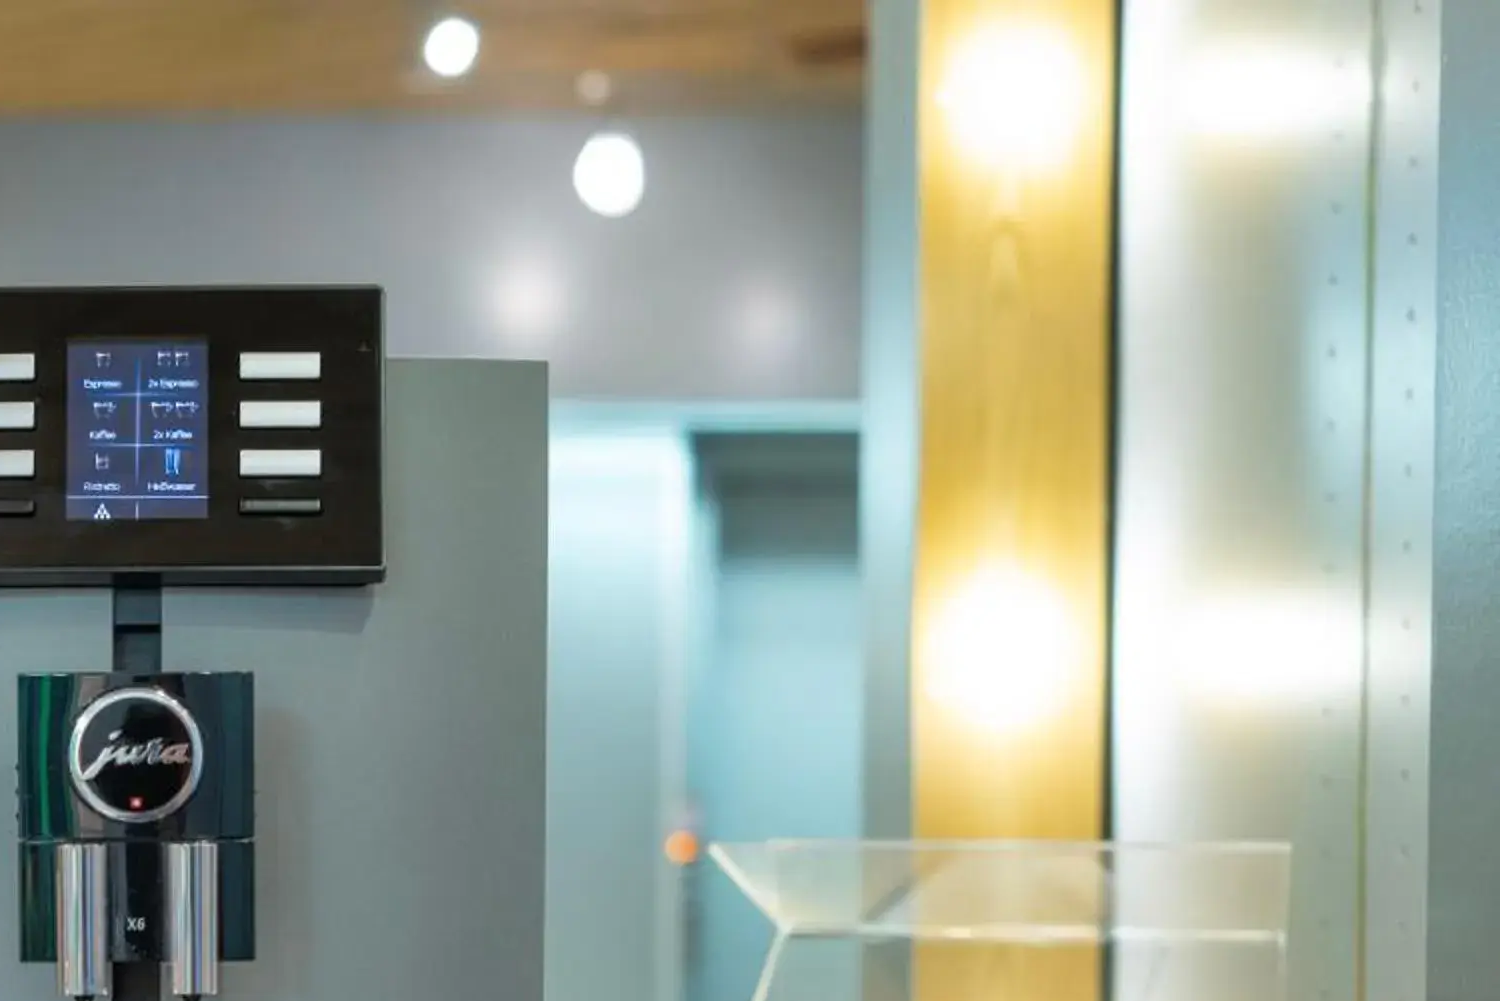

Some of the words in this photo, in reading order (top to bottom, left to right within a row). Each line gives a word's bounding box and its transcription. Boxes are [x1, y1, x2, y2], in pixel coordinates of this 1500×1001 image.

[160, 379, 199, 390] Espresso
[89, 430, 117, 440] Kaffee
[166, 430, 193, 440] Kaffee
[81, 729, 190, 782] jura
[126, 917, 145, 931] X6
